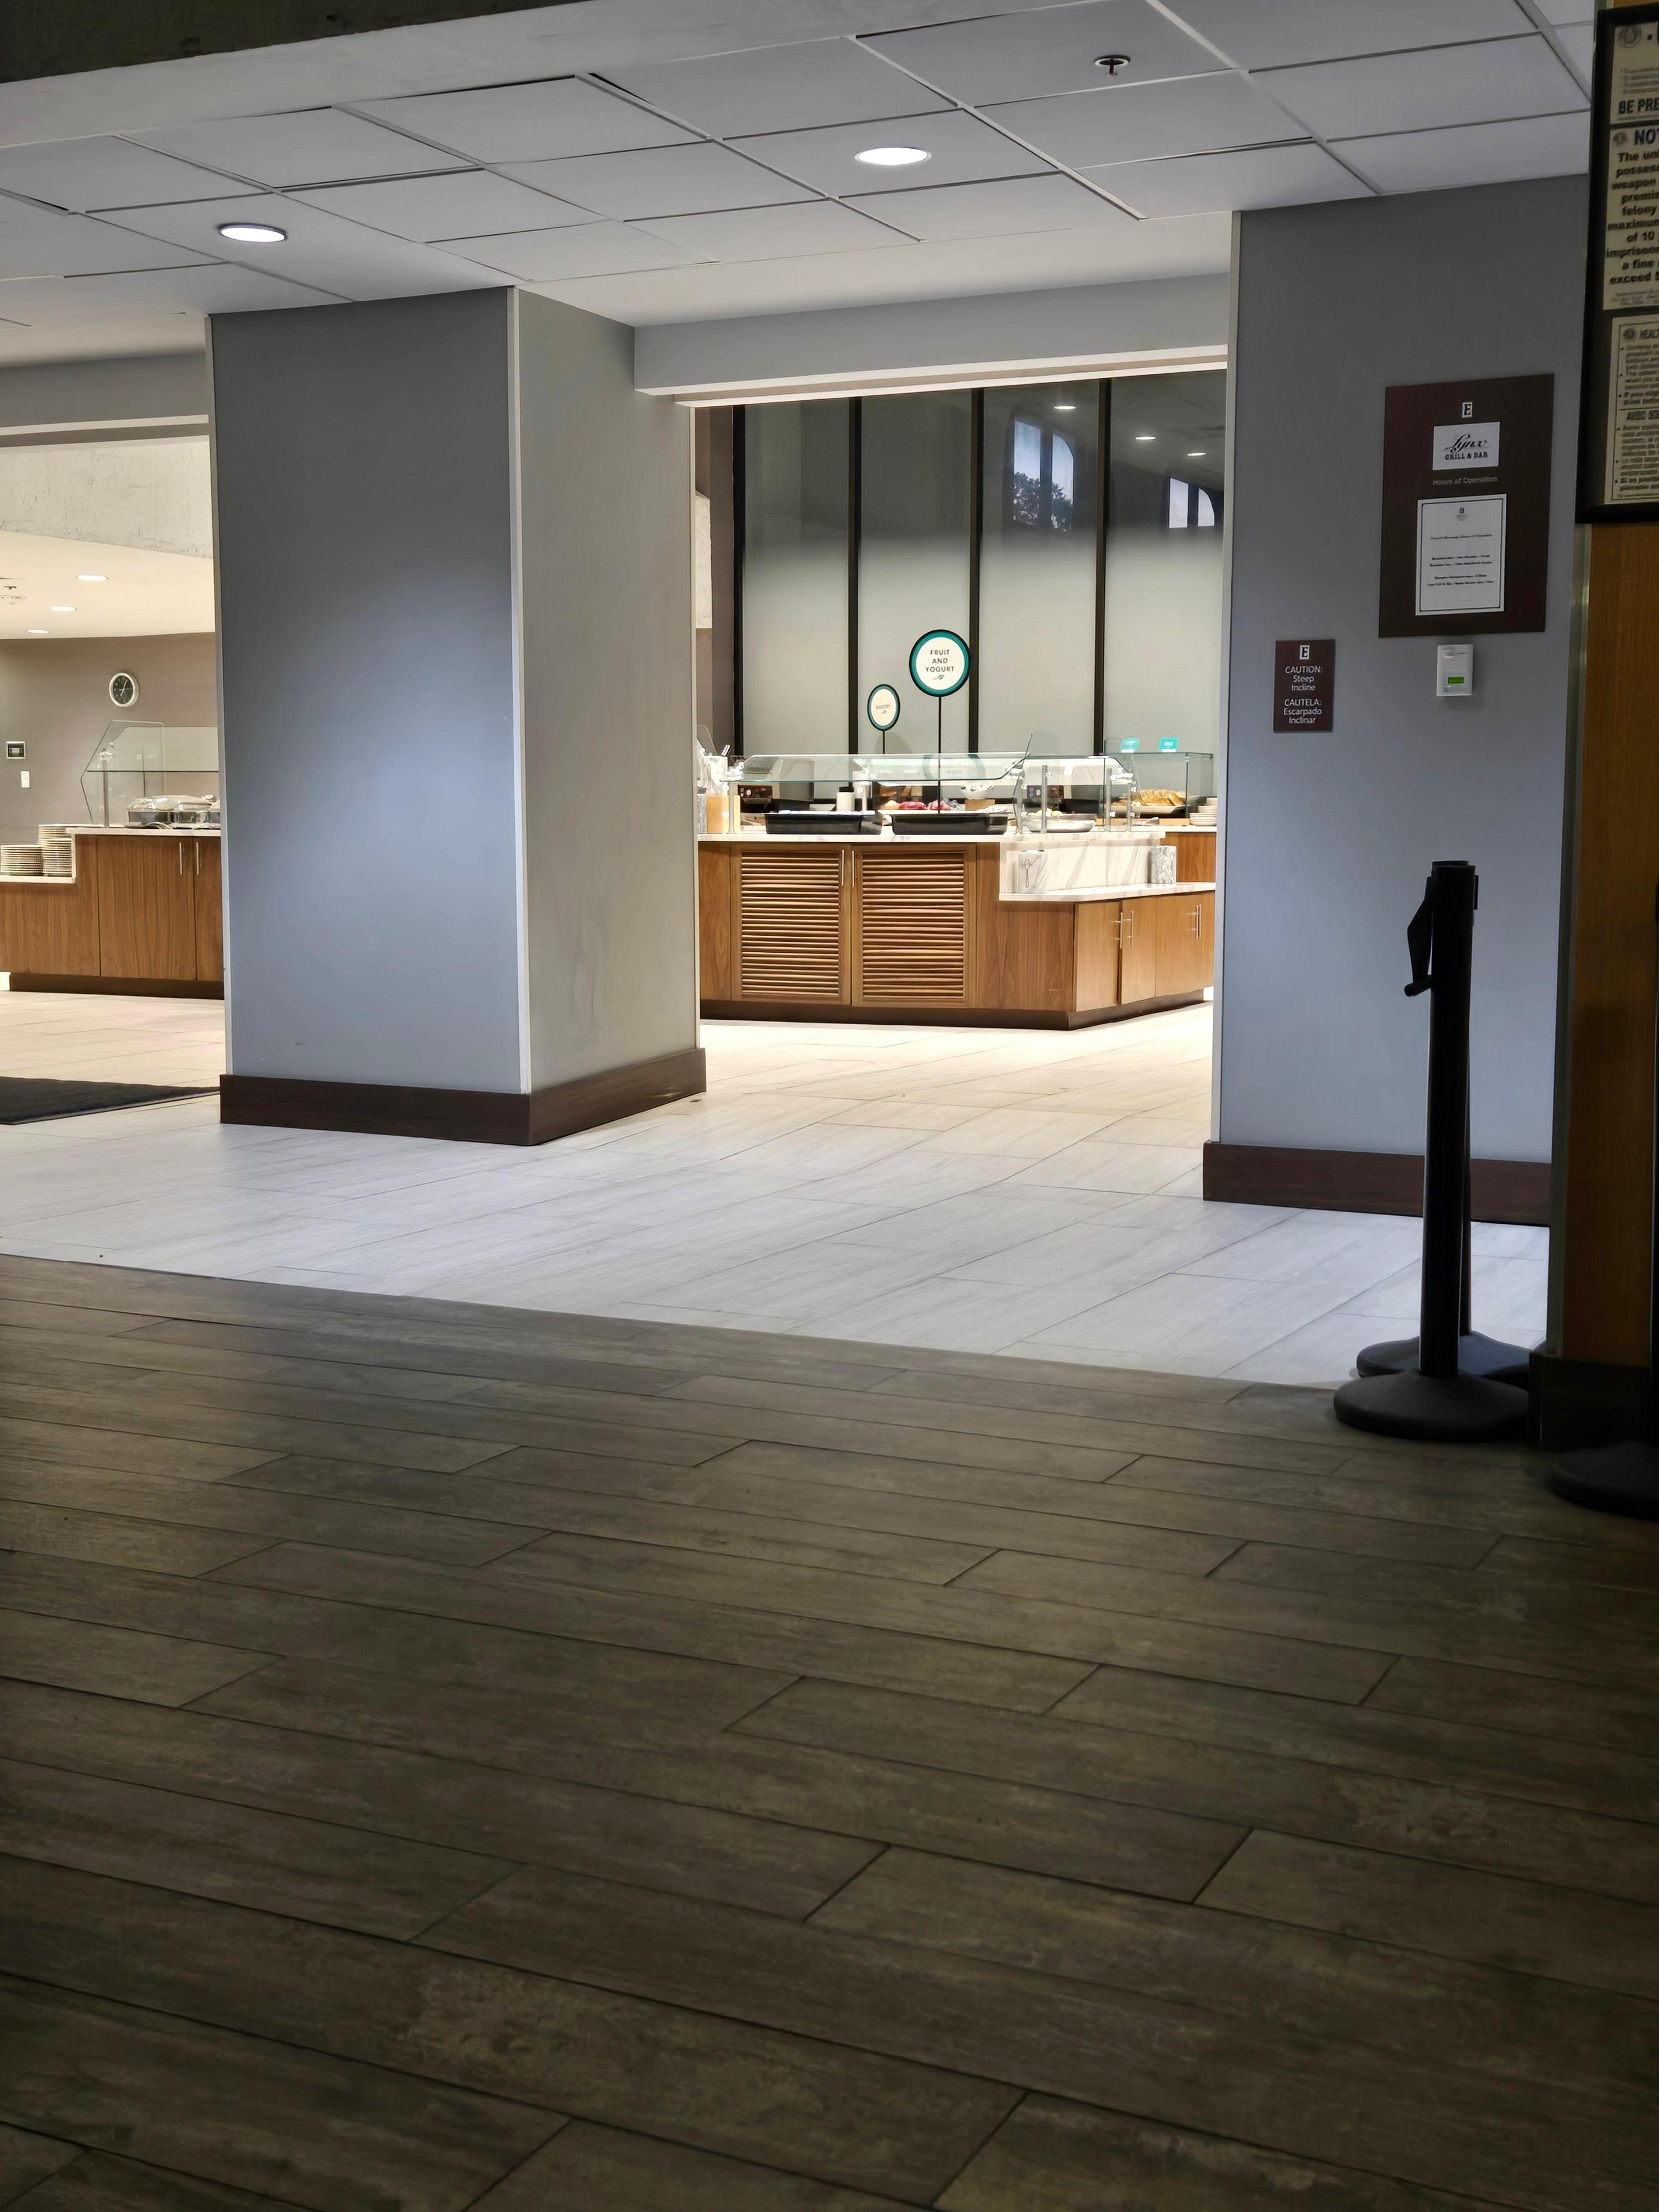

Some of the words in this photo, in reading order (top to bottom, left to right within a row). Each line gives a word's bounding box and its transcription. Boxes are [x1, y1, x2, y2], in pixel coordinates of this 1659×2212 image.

[1619, 100, 1635, 114] BE
[1618, 152, 1640, 163] The
[1611, 178, 1656, 190] weapon
[1622, 205, 1657, 216] felony
[1626, 231, 1639, 243] of
[1642, 231, 1655, 241] 10
[1622, 262, 1629, 270] a
[1633, 258, 1655, 269] fine
[1610, 271, 1651, 284] exceed
[1444, 452, 1466, 461] GRILL
[1463, 476, 1498, 484] Operation
[1285, 665, 1323, 674] CAUTION:
[1292, 675, 1314, 684] Steep
[1284, 698, 1322, 707] CAUTELA:
[1284, 707, 1322, 717] Escarpado
